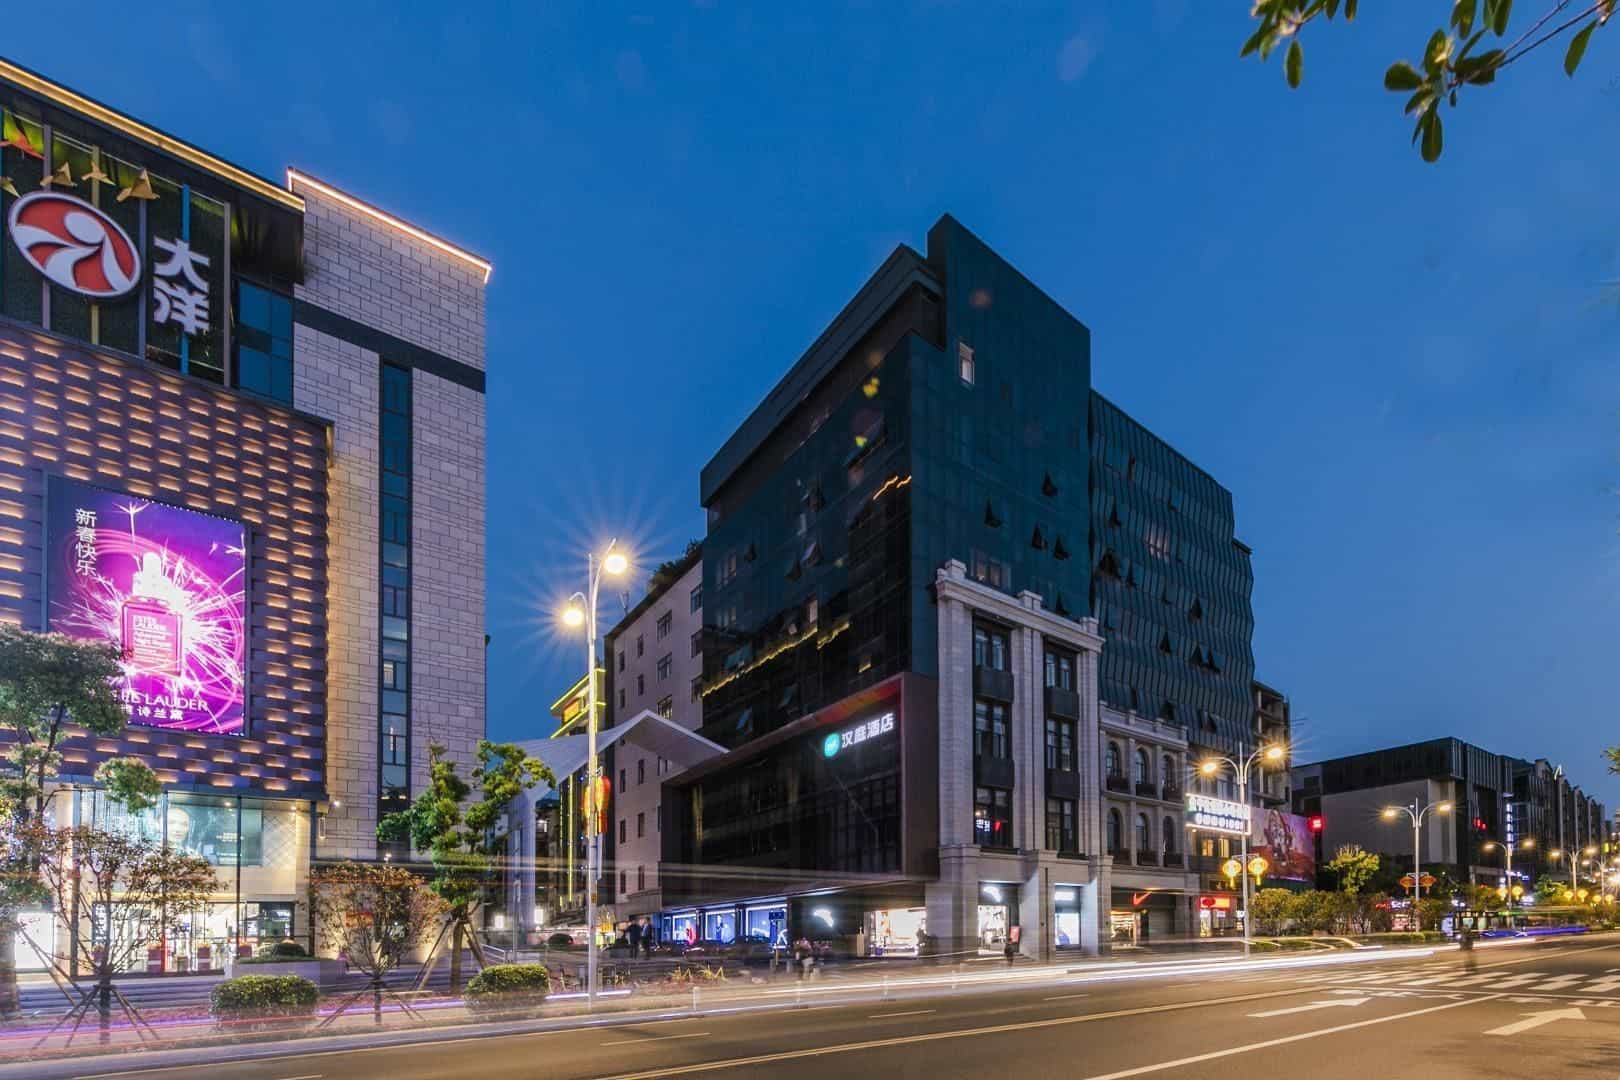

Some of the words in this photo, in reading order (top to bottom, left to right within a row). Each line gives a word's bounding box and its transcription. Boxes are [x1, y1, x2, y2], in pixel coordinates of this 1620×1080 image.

[153, 235, 210, 335] 大洋
[75, 508, 97, 576] 新春快乐
[145, 693, 209, 712] LAUDER
